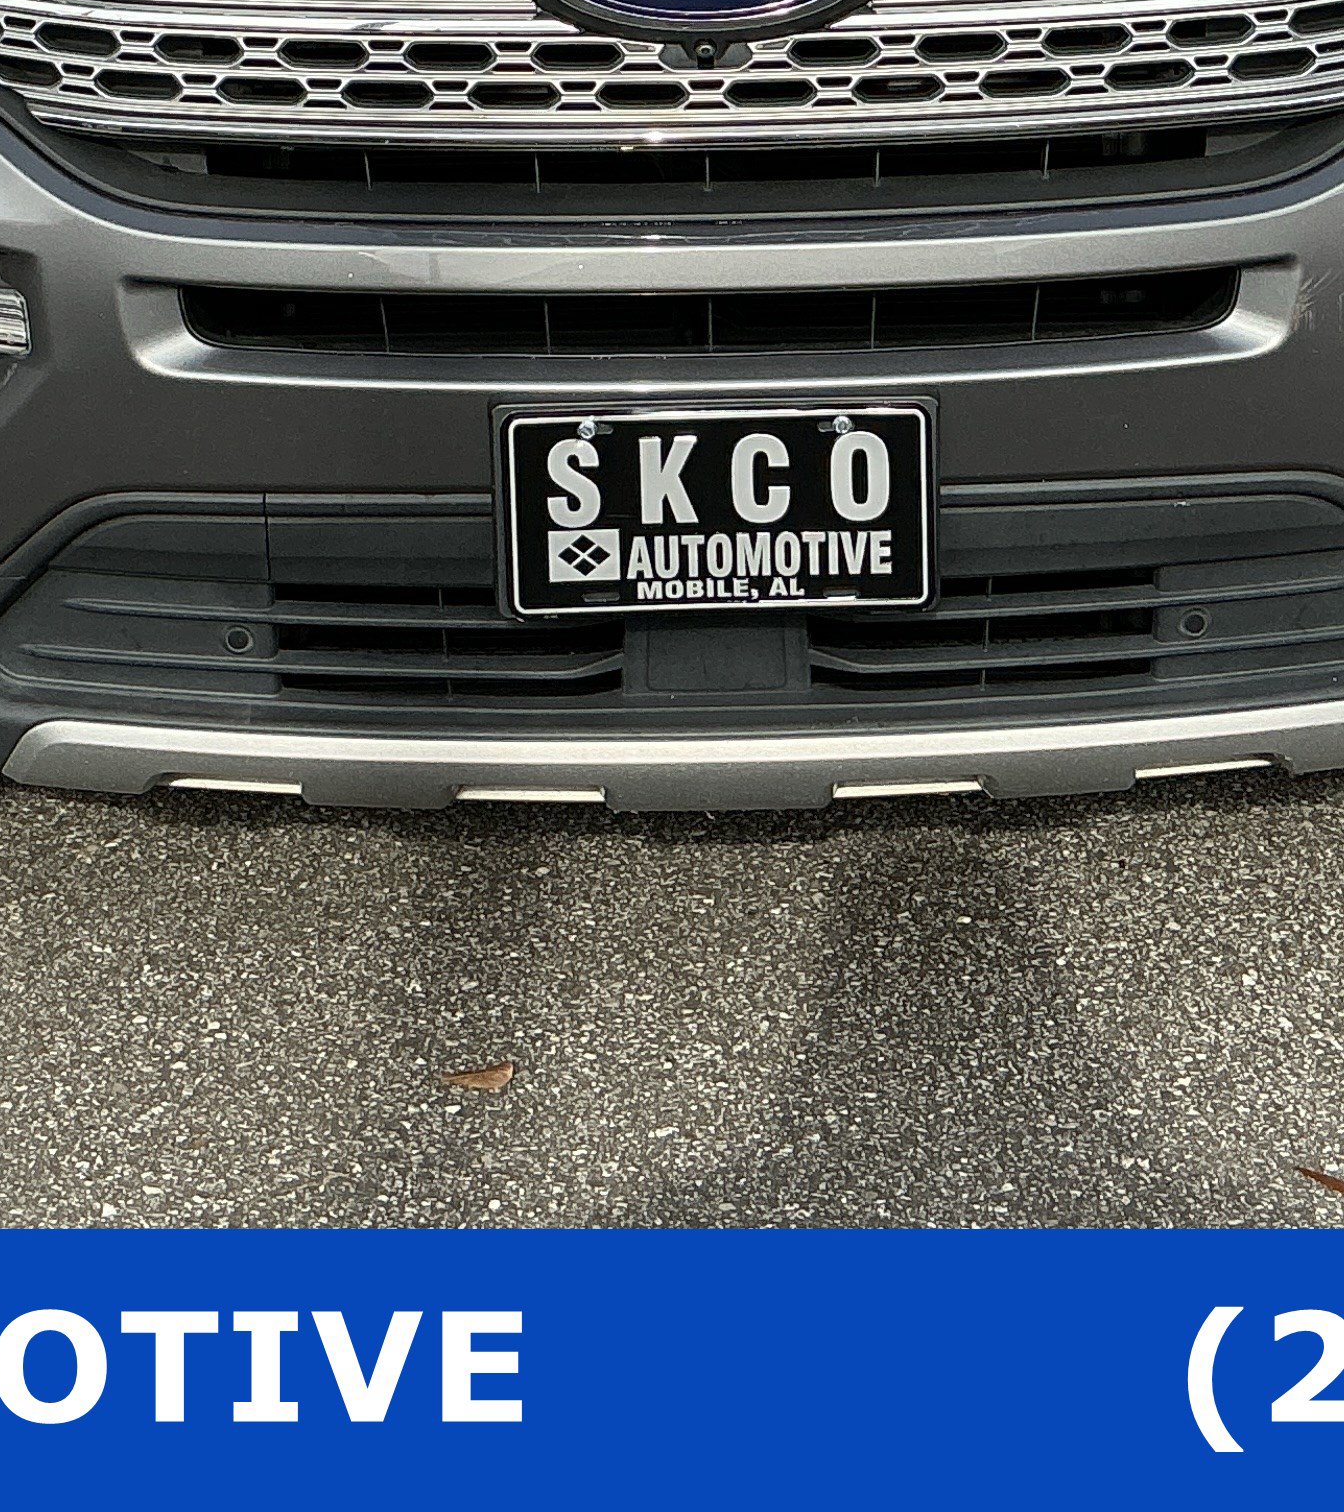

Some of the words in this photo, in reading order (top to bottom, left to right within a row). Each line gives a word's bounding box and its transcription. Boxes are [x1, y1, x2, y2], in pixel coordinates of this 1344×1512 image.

[627, 528, 893, 580] AUTOMOTIVE
[637, 576, 760, 600] MOBILE,
[768, 576, 805, 597] AL
